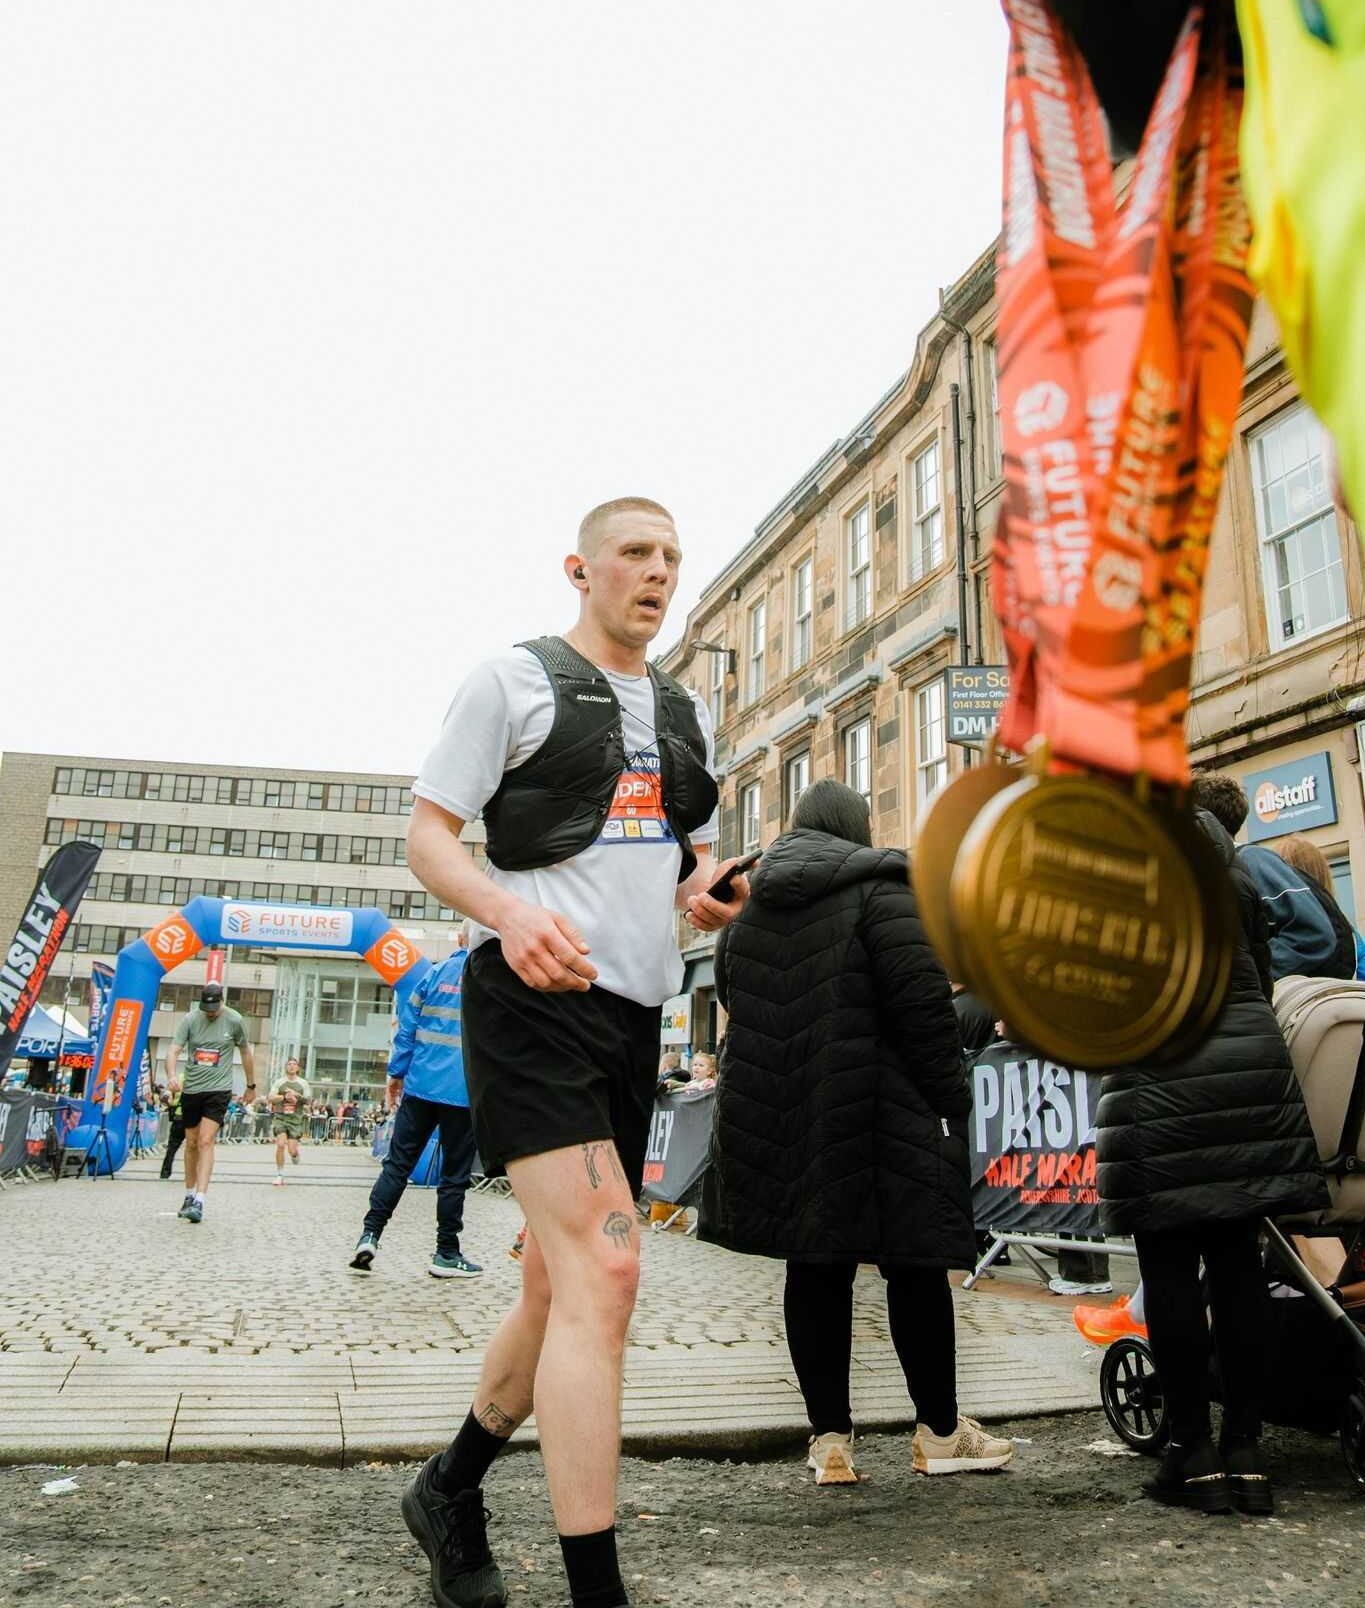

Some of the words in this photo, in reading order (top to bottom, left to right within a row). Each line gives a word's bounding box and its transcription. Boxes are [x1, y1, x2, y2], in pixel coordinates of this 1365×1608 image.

[952, 672, 982, 688] For
[987, 672, 1009, 688] Sa
[577, 694, 611, 704] SALOMON
[953, 700, 972, 709] 0141
[974, 700, 990, 708] 332
[953, 716, 986, 735] DM
[1255, 775, 1315, 815] allstaff
[260, 912, 341, 930] FUTURE
[259, 927, 297, 937] SPORTS
[974, 1059, 1098, 1152] PAISL
[646, 1111, 675, 1160] LEY
[984, 1152, 1033, 1188] HALF
[1036, 1148, 1097, 1187] MARA
